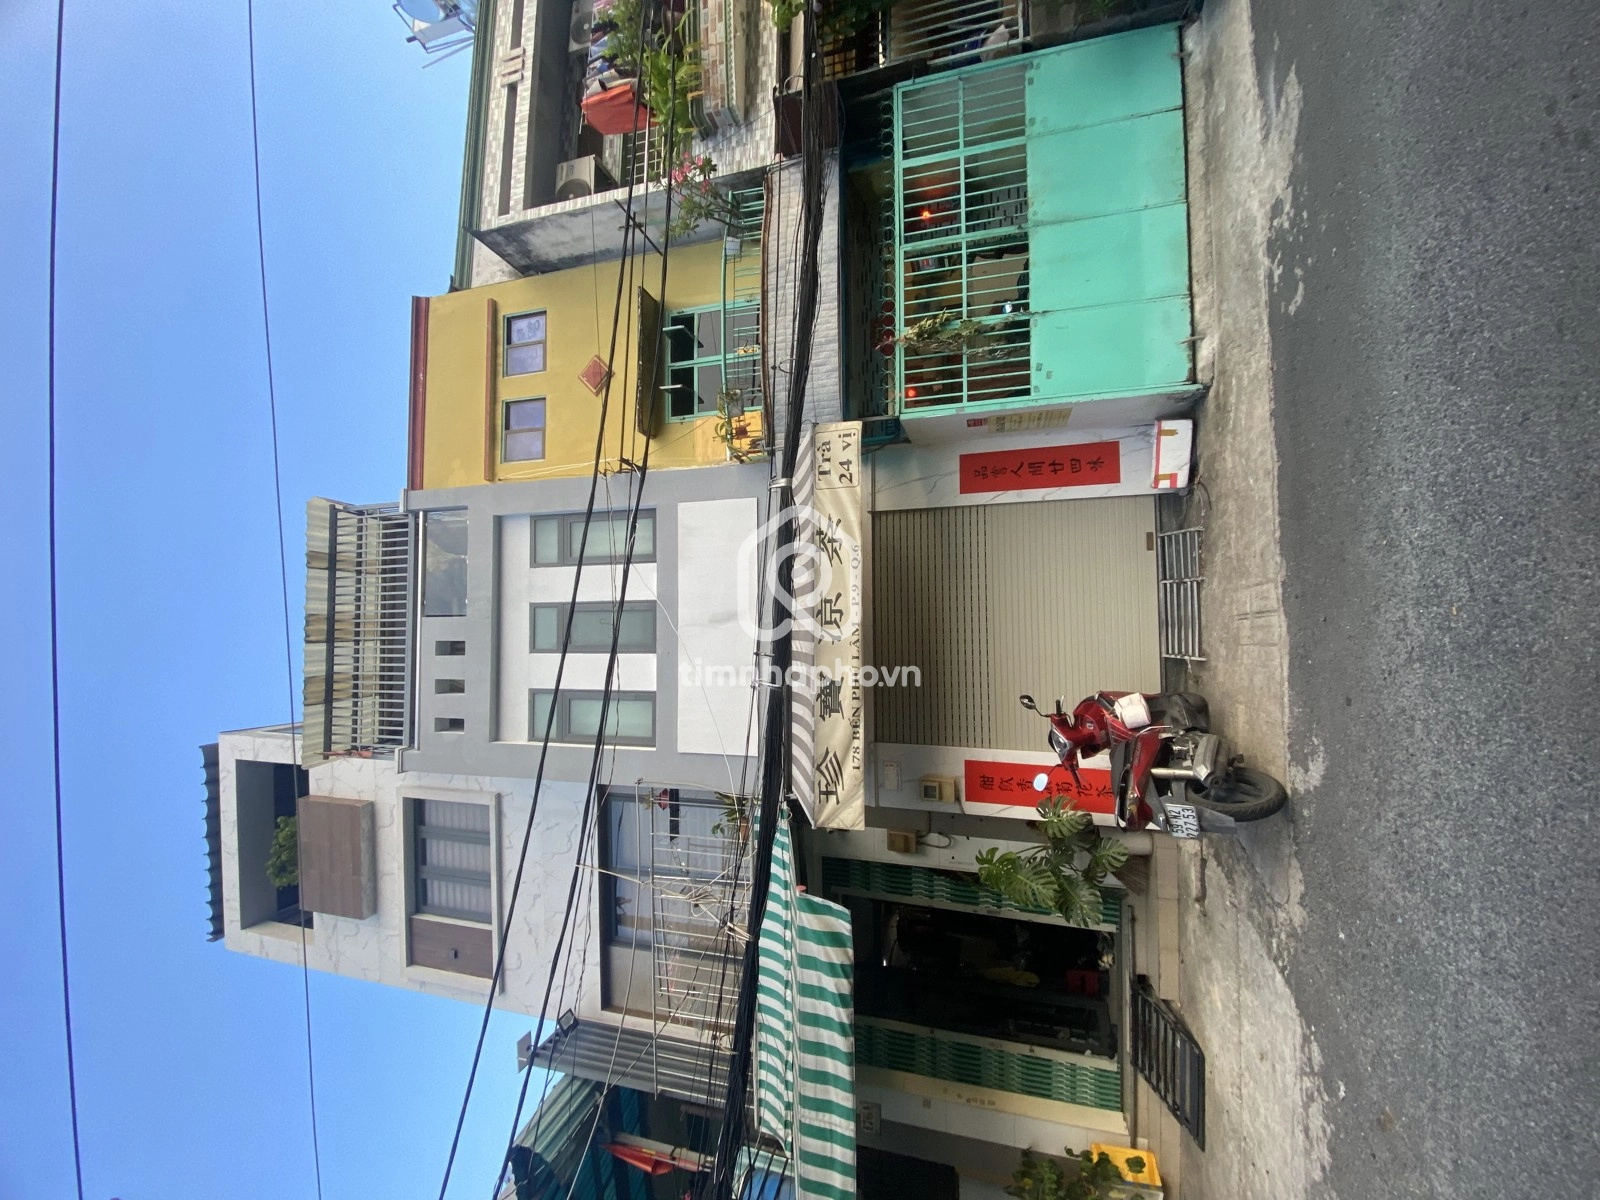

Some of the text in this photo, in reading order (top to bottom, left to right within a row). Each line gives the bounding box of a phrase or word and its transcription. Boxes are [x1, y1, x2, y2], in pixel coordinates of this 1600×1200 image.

[816, 440, 831, 481] Trà
[838, 432, 856, 484] 24 vị
[850, 544, 860, 570] Q.6
[850, 584, 860, 606] P.9
[848, 622, 860, 660] LÂM
[848, 706, 860, 740] BẾN
[851, 746, 860, 771] 178
